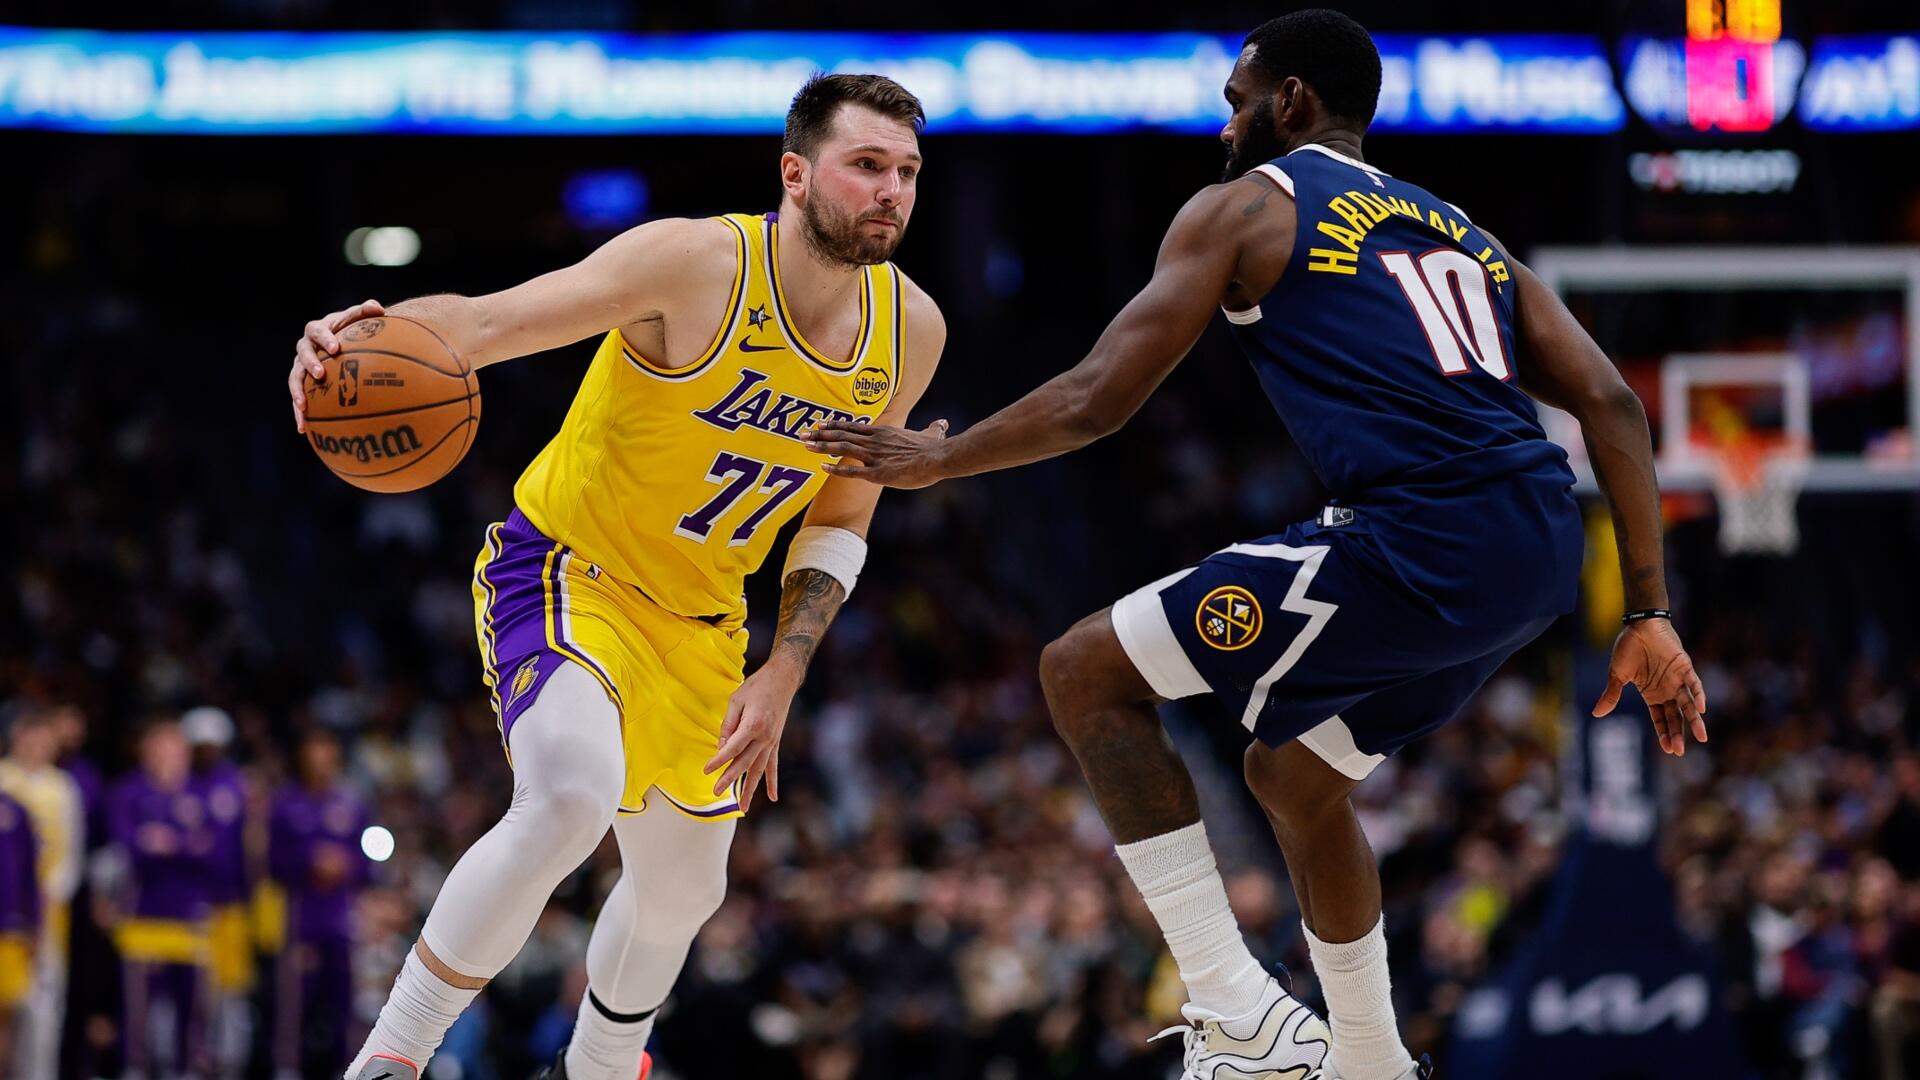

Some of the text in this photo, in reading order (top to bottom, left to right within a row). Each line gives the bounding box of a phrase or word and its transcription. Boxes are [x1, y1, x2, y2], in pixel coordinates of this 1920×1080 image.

[1308, 191, 1469, 275] HARDAWAY
[1376, 247, 1512, 381] 10
[691, 367, 873, 446] LAKE
[855, 377, 887, 394] bibigo
[311, 424, 423, 463] Wilson
[673, 450, 815, 549] 77
